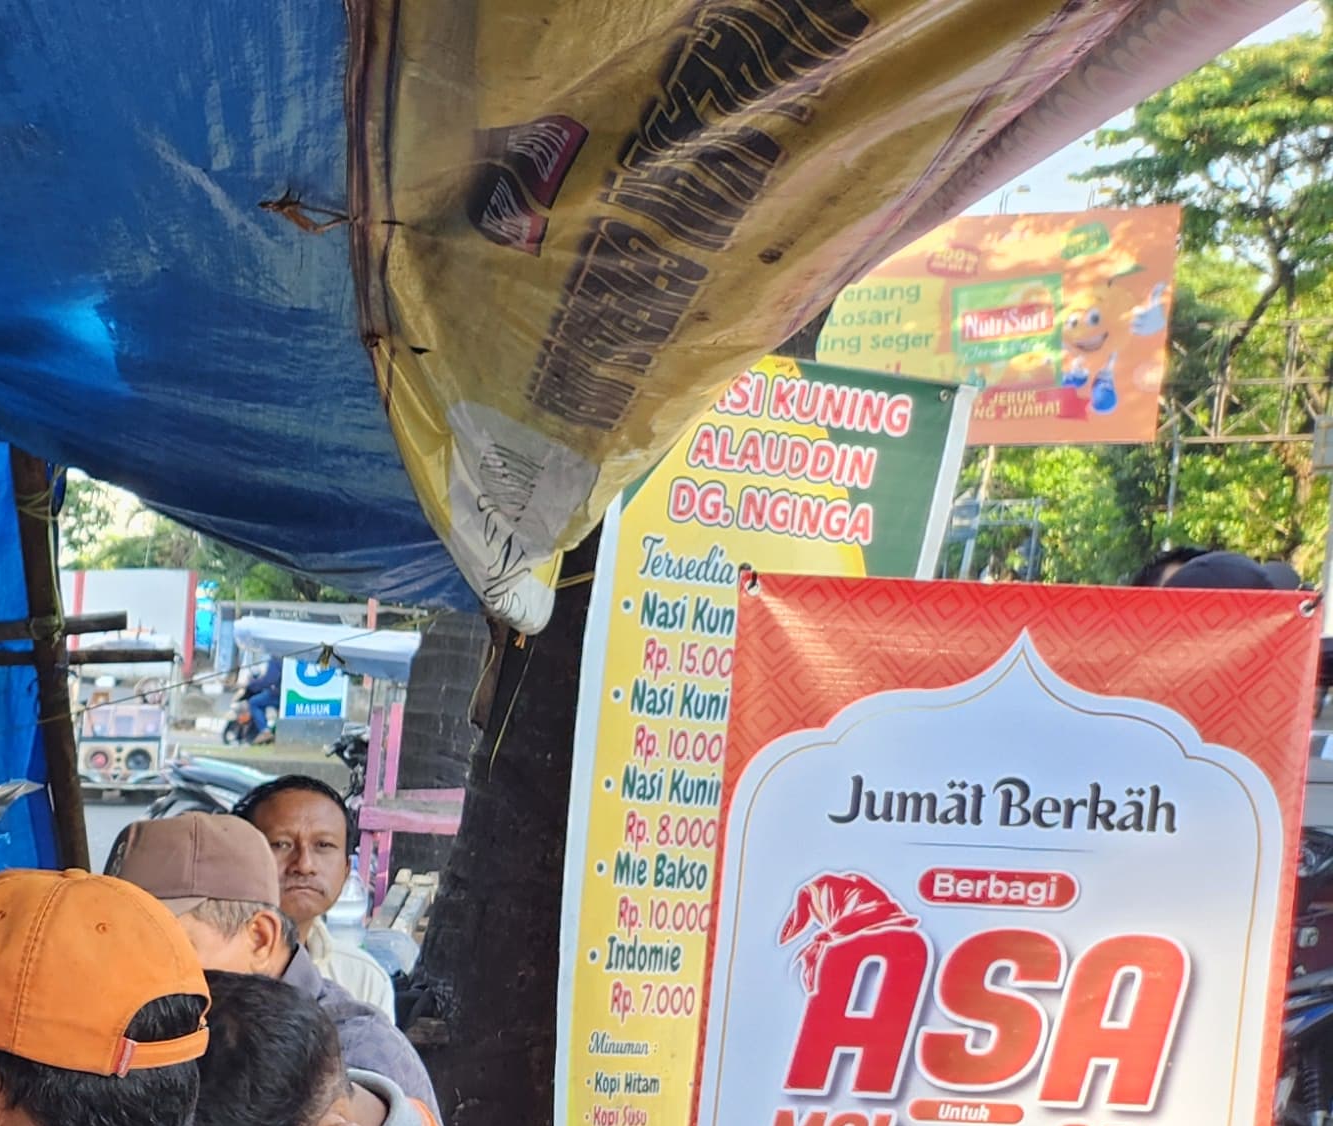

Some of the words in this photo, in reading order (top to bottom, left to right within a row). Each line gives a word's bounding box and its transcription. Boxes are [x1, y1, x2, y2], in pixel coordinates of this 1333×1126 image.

[839, 284, 921, 303] enang
[869, 330, 934, 350] seger
[714, 371, 764, 416] SI
[771, 378, 912, 436] KUNING
[687, 426, 877, 488] ALAUDDIN
[670, 478, 732, 524] DG.
[739, 488, 873, 544] NGINGA
[640, 535, 735, 584] Tersedia
[640, 591, 688, 630] Nasi
[643, 638, 671, 680] Rp.
[631, 677, 675, 716] Nasi
[633, 724, 660, 766] Rp.
[621, 764, 665, 801] Nasi
[624, 811, 650, 852] Rp.
[614, 852, 647, 886] Mie
[652, 852, 707, 891] Bakso
[932, 872, 1058, 904] Berbagi
[618, 899, 645, 936] Rp.
[604, 935, 681, 972] Indomie
[610, 982, 637, 1022] Rp.
[641, 983, 695, 1017] 7.000
[783, 928, 1191, 1112] ASA
[588, 1031, 649, 1057] Minuman
[594, 1072, 620, 1095] Kopi
[624, 1072, 660, 1094] Hitam
[622, 1105, 648, 1126] Susu
[937, 1103, 991, 1121] Untuk
